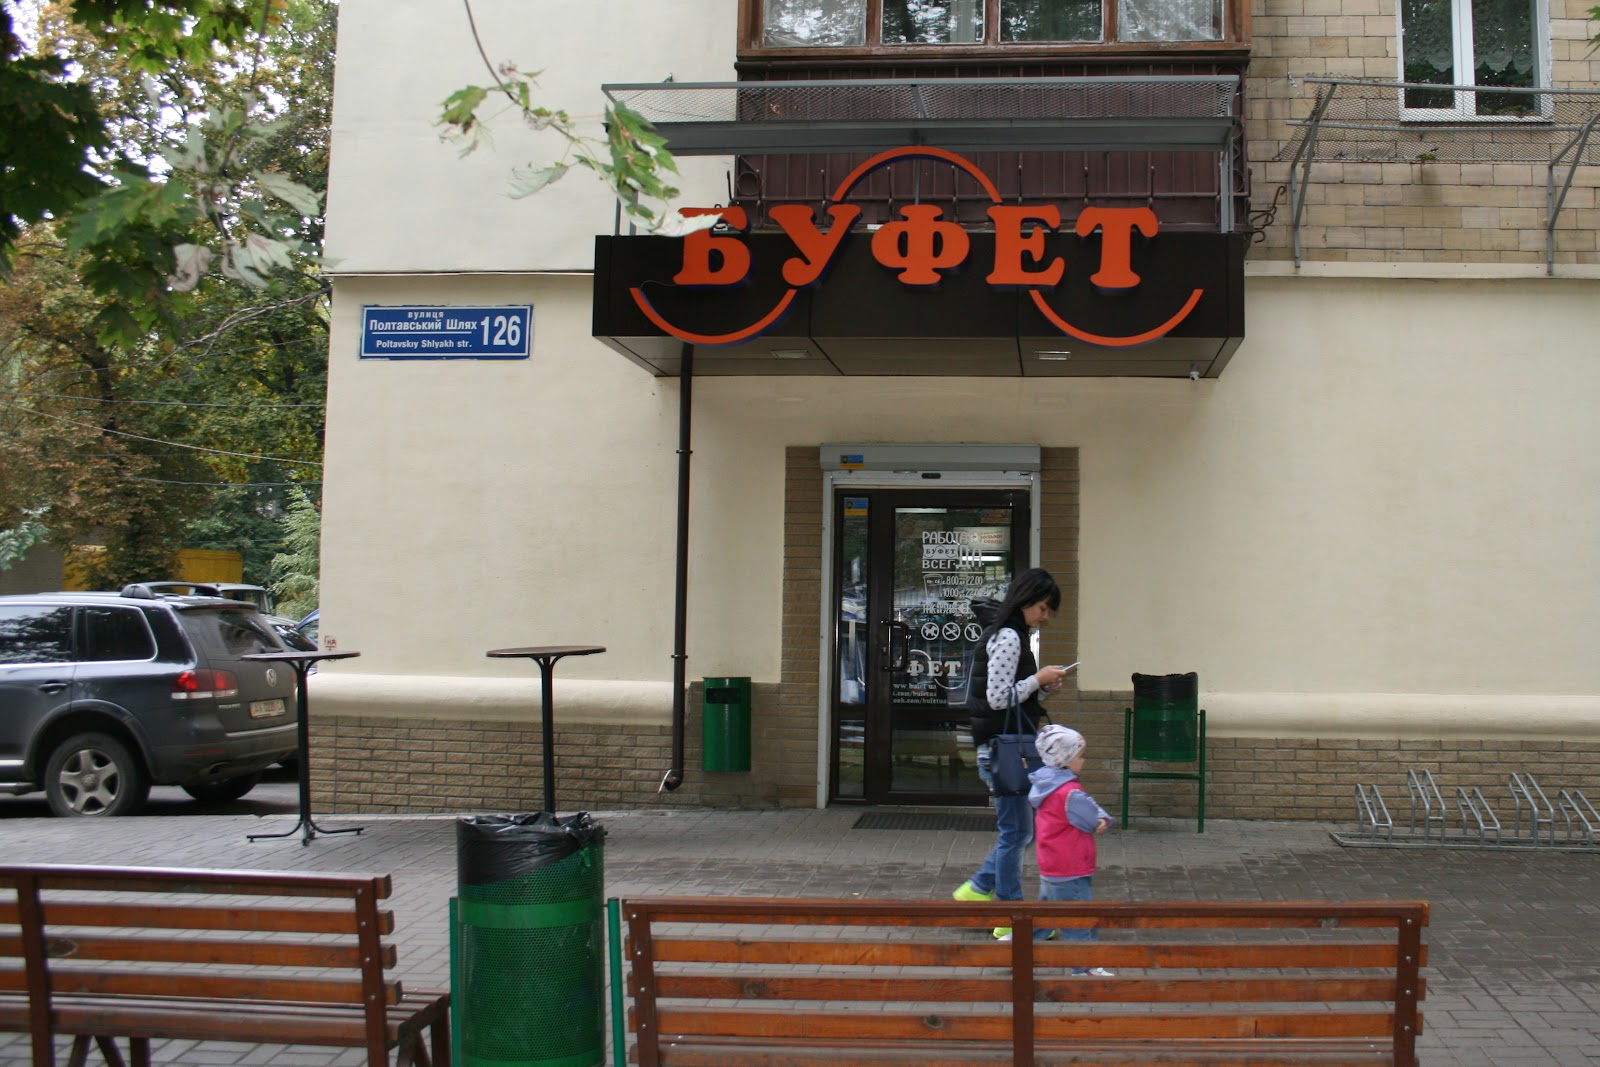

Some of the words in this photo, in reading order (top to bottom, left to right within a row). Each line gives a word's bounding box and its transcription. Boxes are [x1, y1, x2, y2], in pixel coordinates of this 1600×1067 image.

[673, 204, 1159, 288] БУФЕТ
[407, 312, 444, 320] вулиця
[369, 319, 442, 331] Полтавський
[446, 319, 477, 330] Шлях
[480, 315, 521, 346] 126
[421, 339, 454, 349] Shlyakh
[457, 340, 472, 348] str.
[906, 660, 961, 677] ФЕТ
